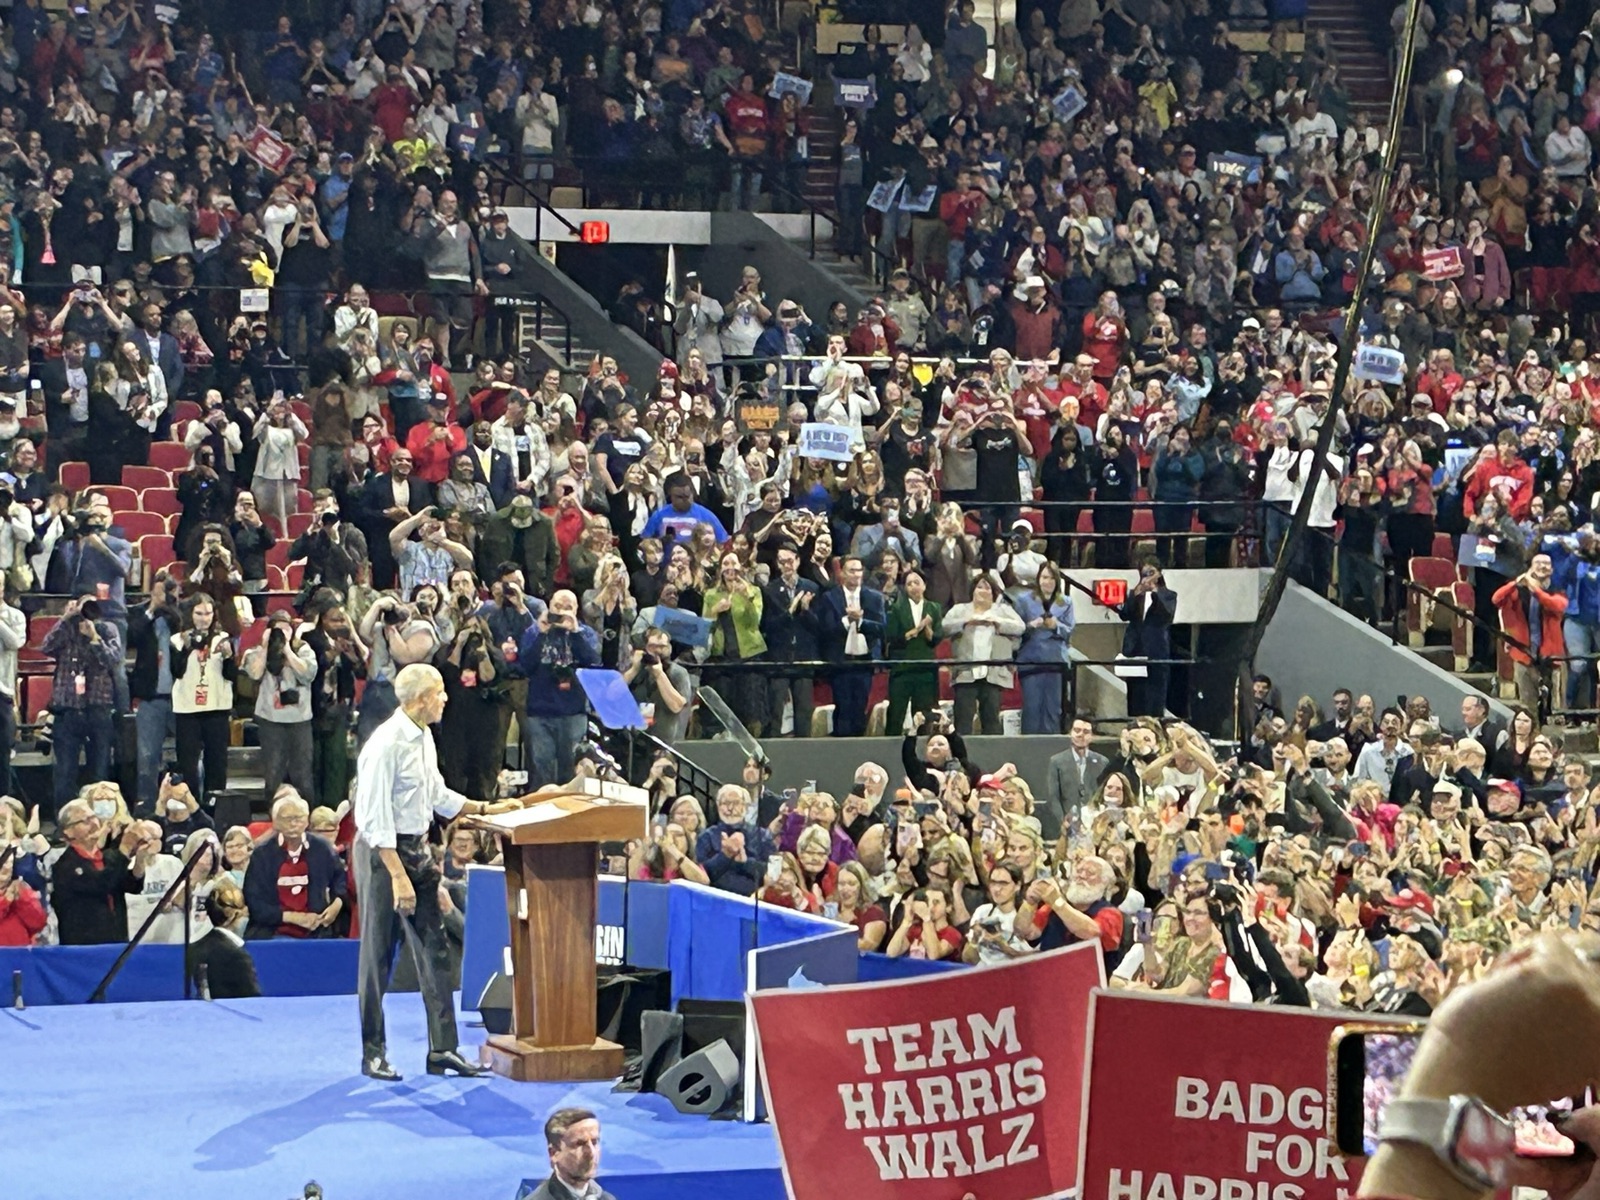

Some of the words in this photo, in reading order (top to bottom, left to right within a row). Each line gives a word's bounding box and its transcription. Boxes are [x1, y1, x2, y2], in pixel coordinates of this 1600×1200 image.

[846, 1006, 1022, 1074] TEAM
[838, 1057, 1046, 1129] HARRIS
[863, 1113, 1039, 1180] WALZ
[1246, 1131, 1349, 1180] FOR
